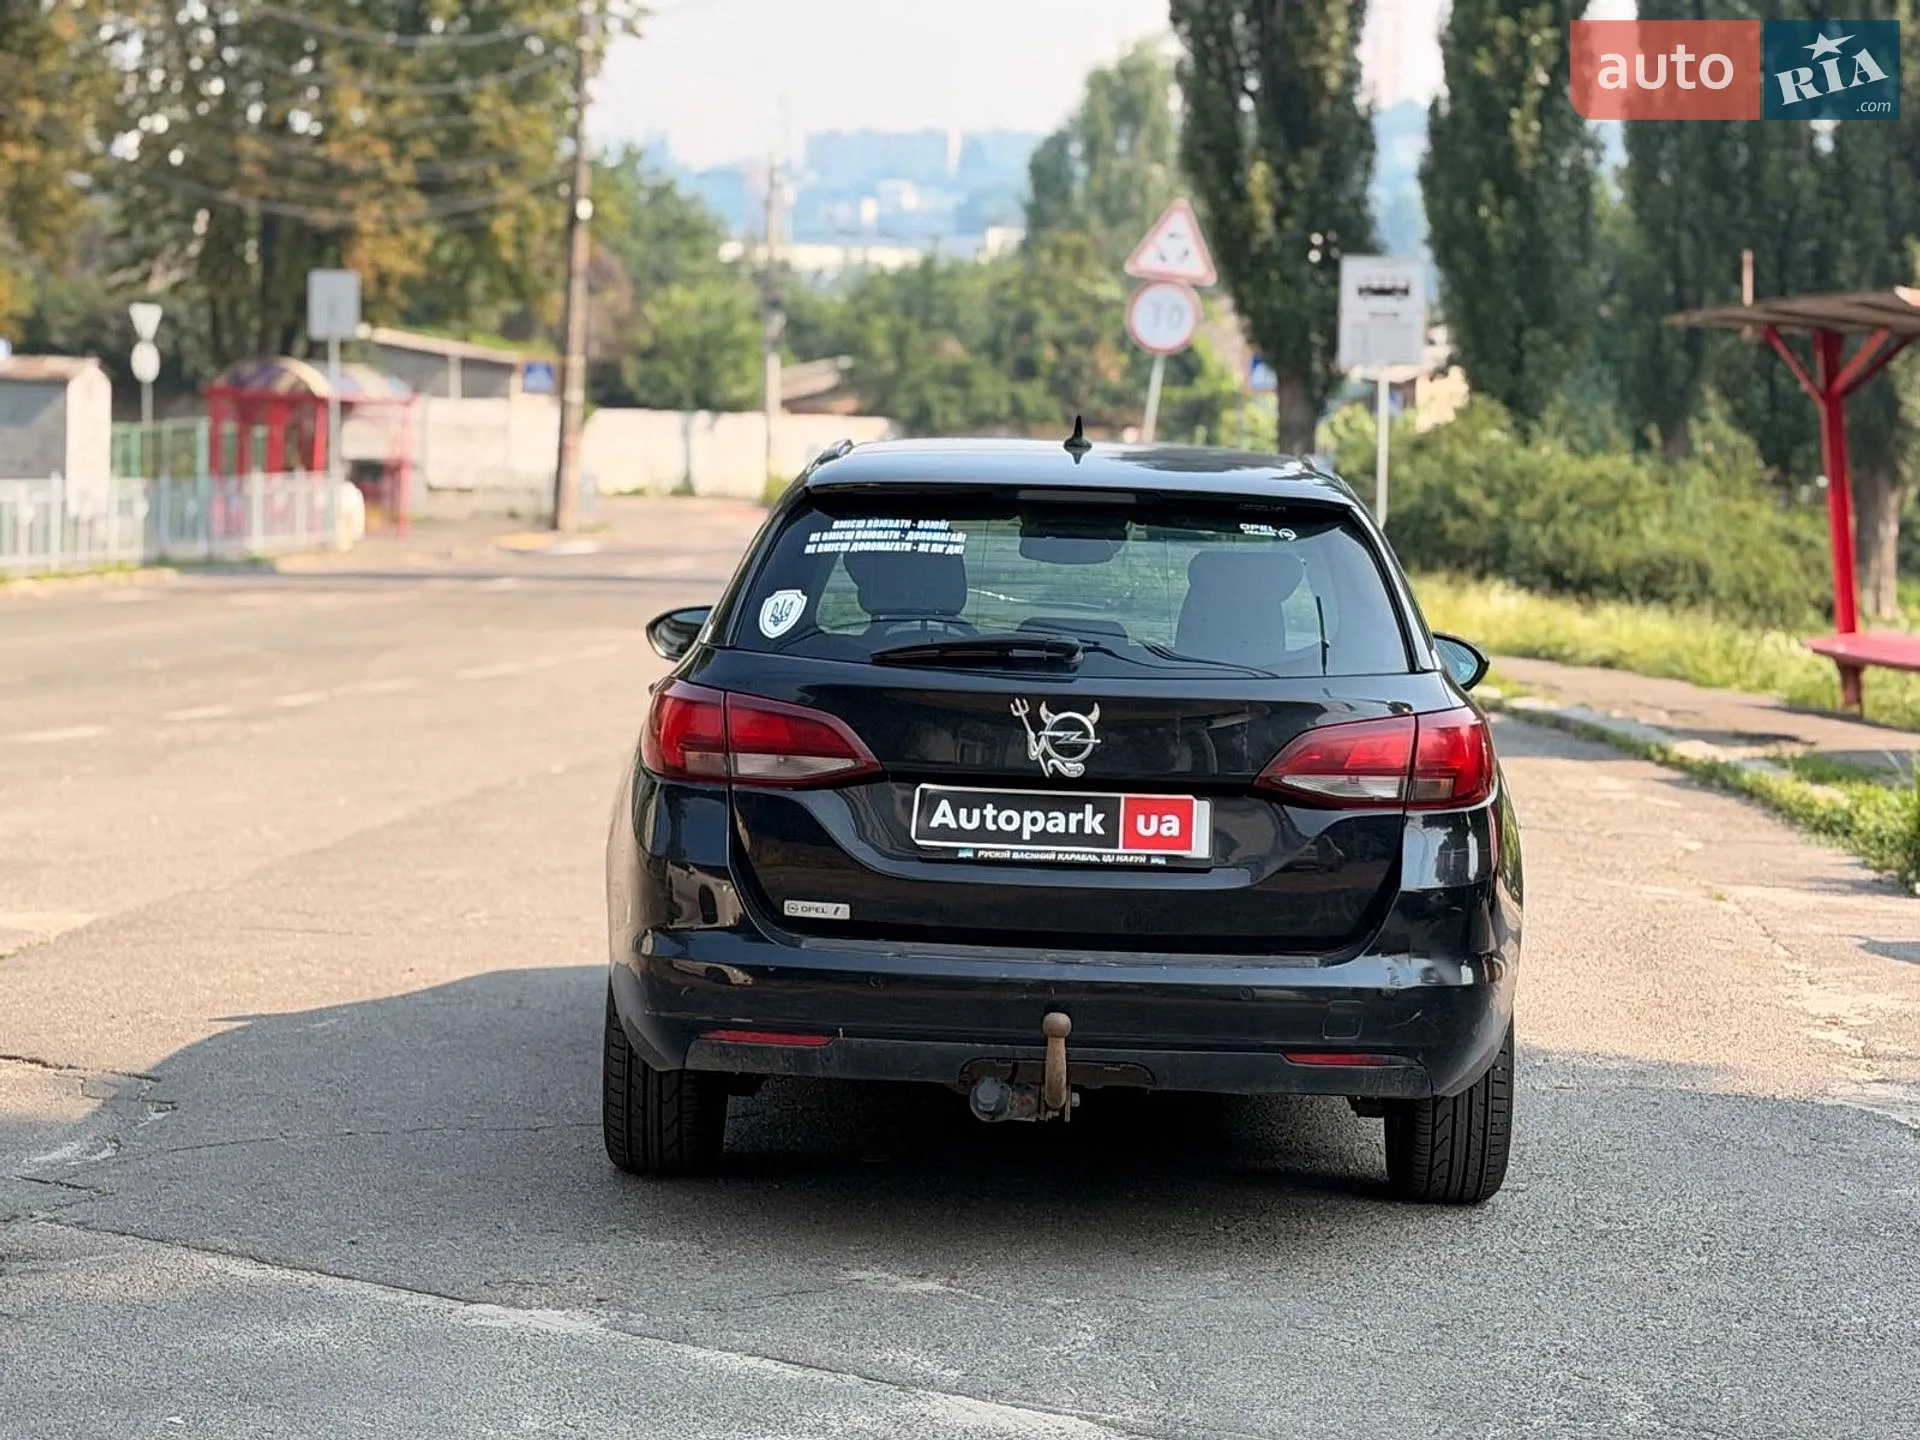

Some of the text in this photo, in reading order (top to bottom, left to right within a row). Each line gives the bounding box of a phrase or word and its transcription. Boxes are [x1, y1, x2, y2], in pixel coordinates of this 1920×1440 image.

[1149, 301, 1185, 329] 70
[929, 798, 1180, 840] Autopark ua
[801, 905, 827, 914] OPEL
